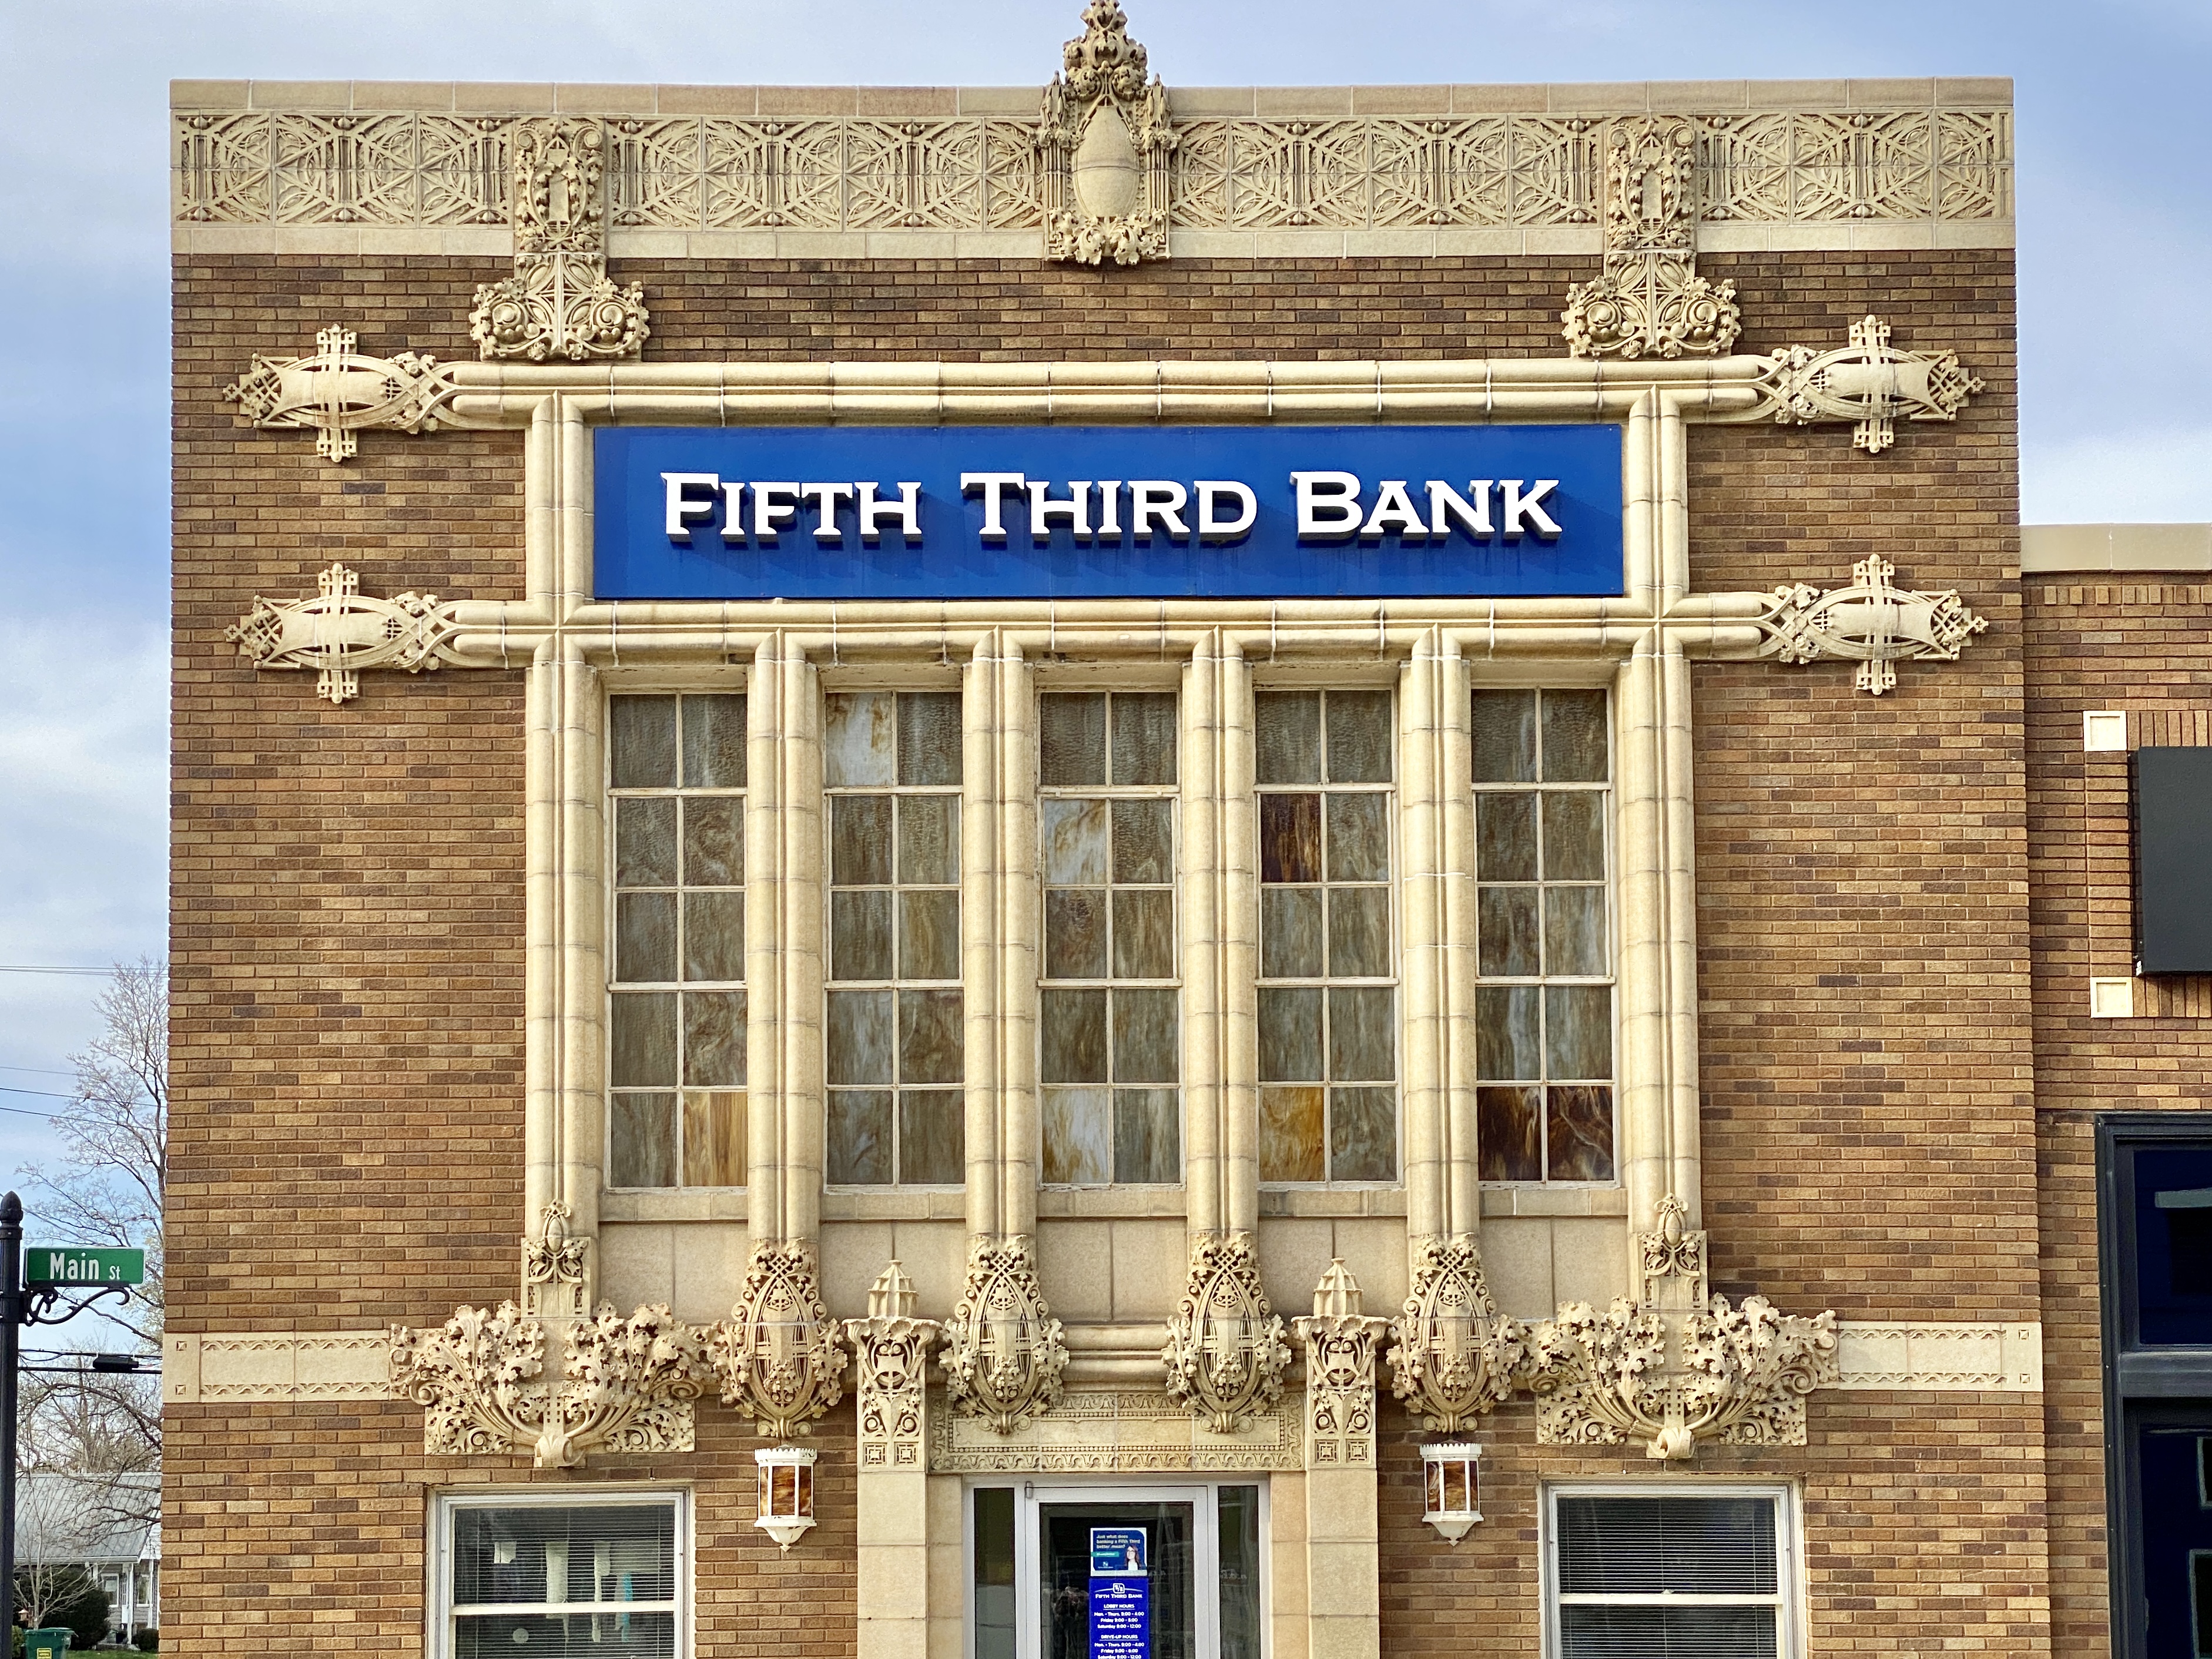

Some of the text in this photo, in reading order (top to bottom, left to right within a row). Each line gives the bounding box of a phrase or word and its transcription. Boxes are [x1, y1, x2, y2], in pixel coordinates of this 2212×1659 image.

[660, 471, 1563, 542] FIFTH THIRD BANK
[50, 1252, 121, 1280] Main St
